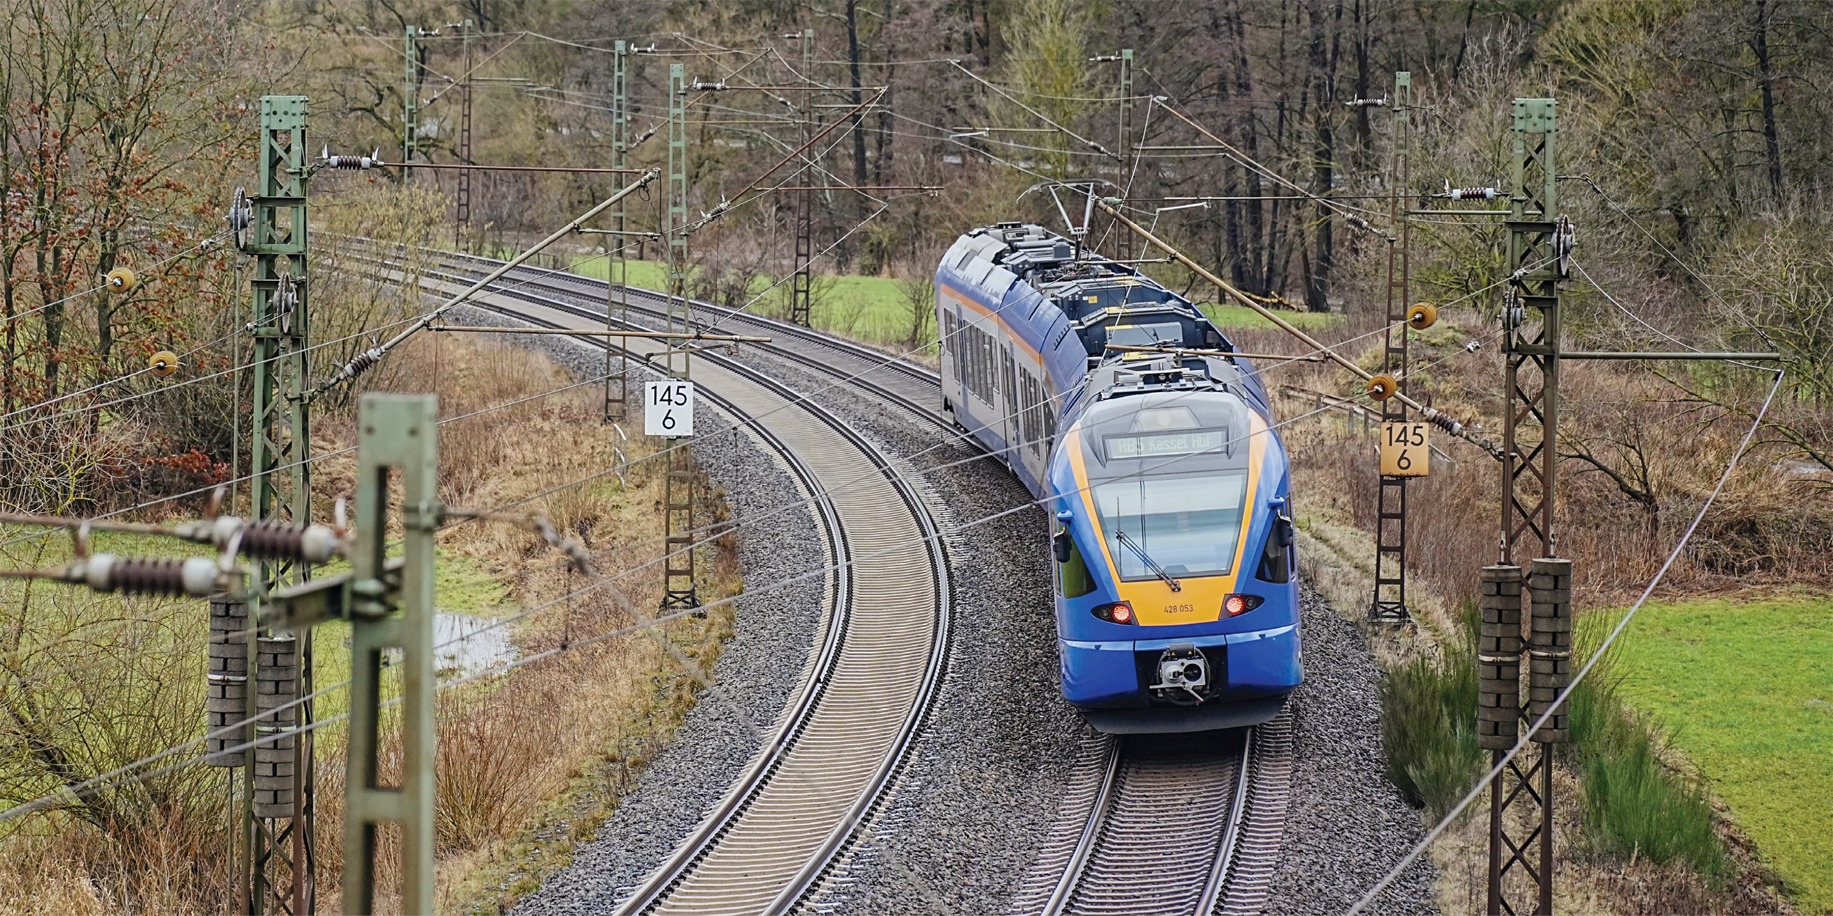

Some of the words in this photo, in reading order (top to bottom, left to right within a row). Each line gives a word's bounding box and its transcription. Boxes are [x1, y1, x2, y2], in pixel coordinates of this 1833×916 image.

[651, 385, 687, 406] 145
[662, 409, 676, 430] 6
[1149, 436, 1189, 451] Kassel
[1192, 435, 1211, 449] Hbf
[1386, 425, 1424, 447] 145
[1397, 449, 1412, 470] 6
[1163, 605, 1178, 613] 428
[1179, 604, 1194, 612] 053
